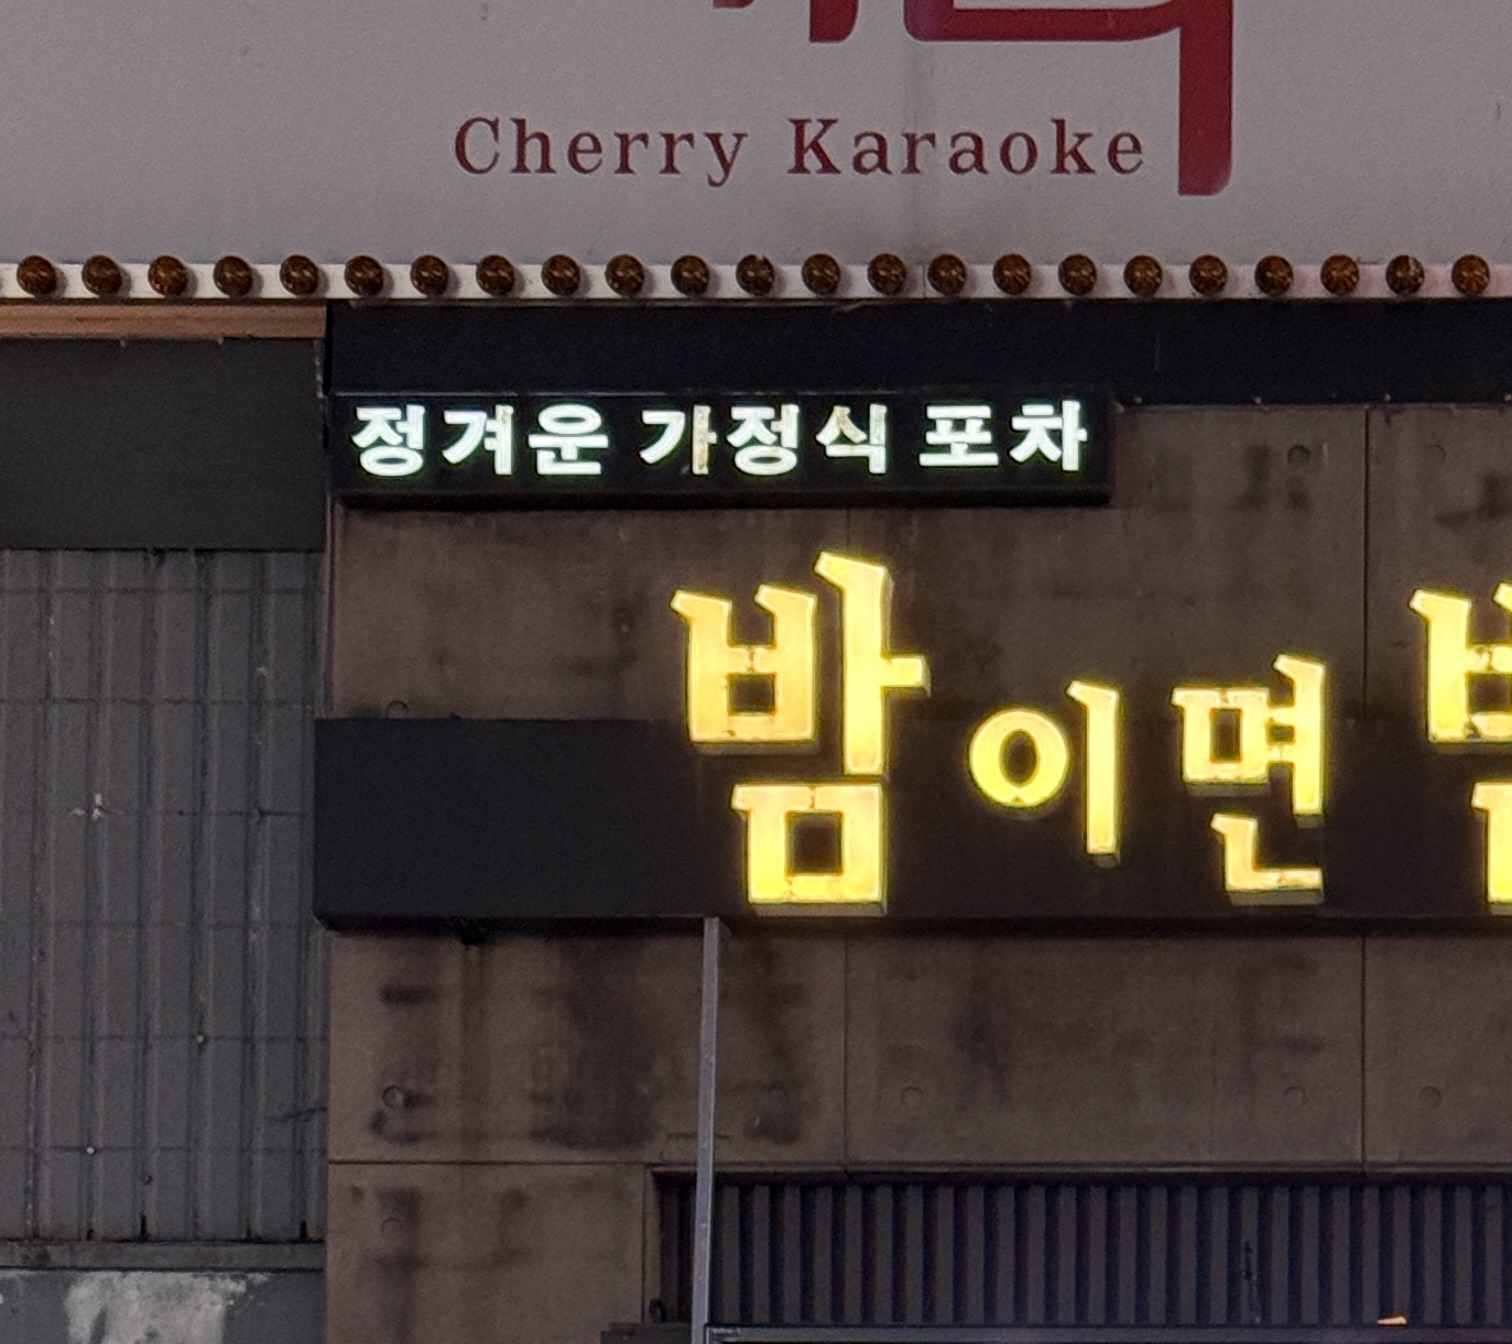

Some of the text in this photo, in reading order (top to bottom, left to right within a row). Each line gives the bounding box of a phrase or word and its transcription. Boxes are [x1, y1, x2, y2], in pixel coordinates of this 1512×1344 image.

[455, 117, 1146, 188] Cherry Karaoke
[351, 401, 1088, 477] 정겨운 가정식 포차
[671, 550, 1326, 910] 밤이면
